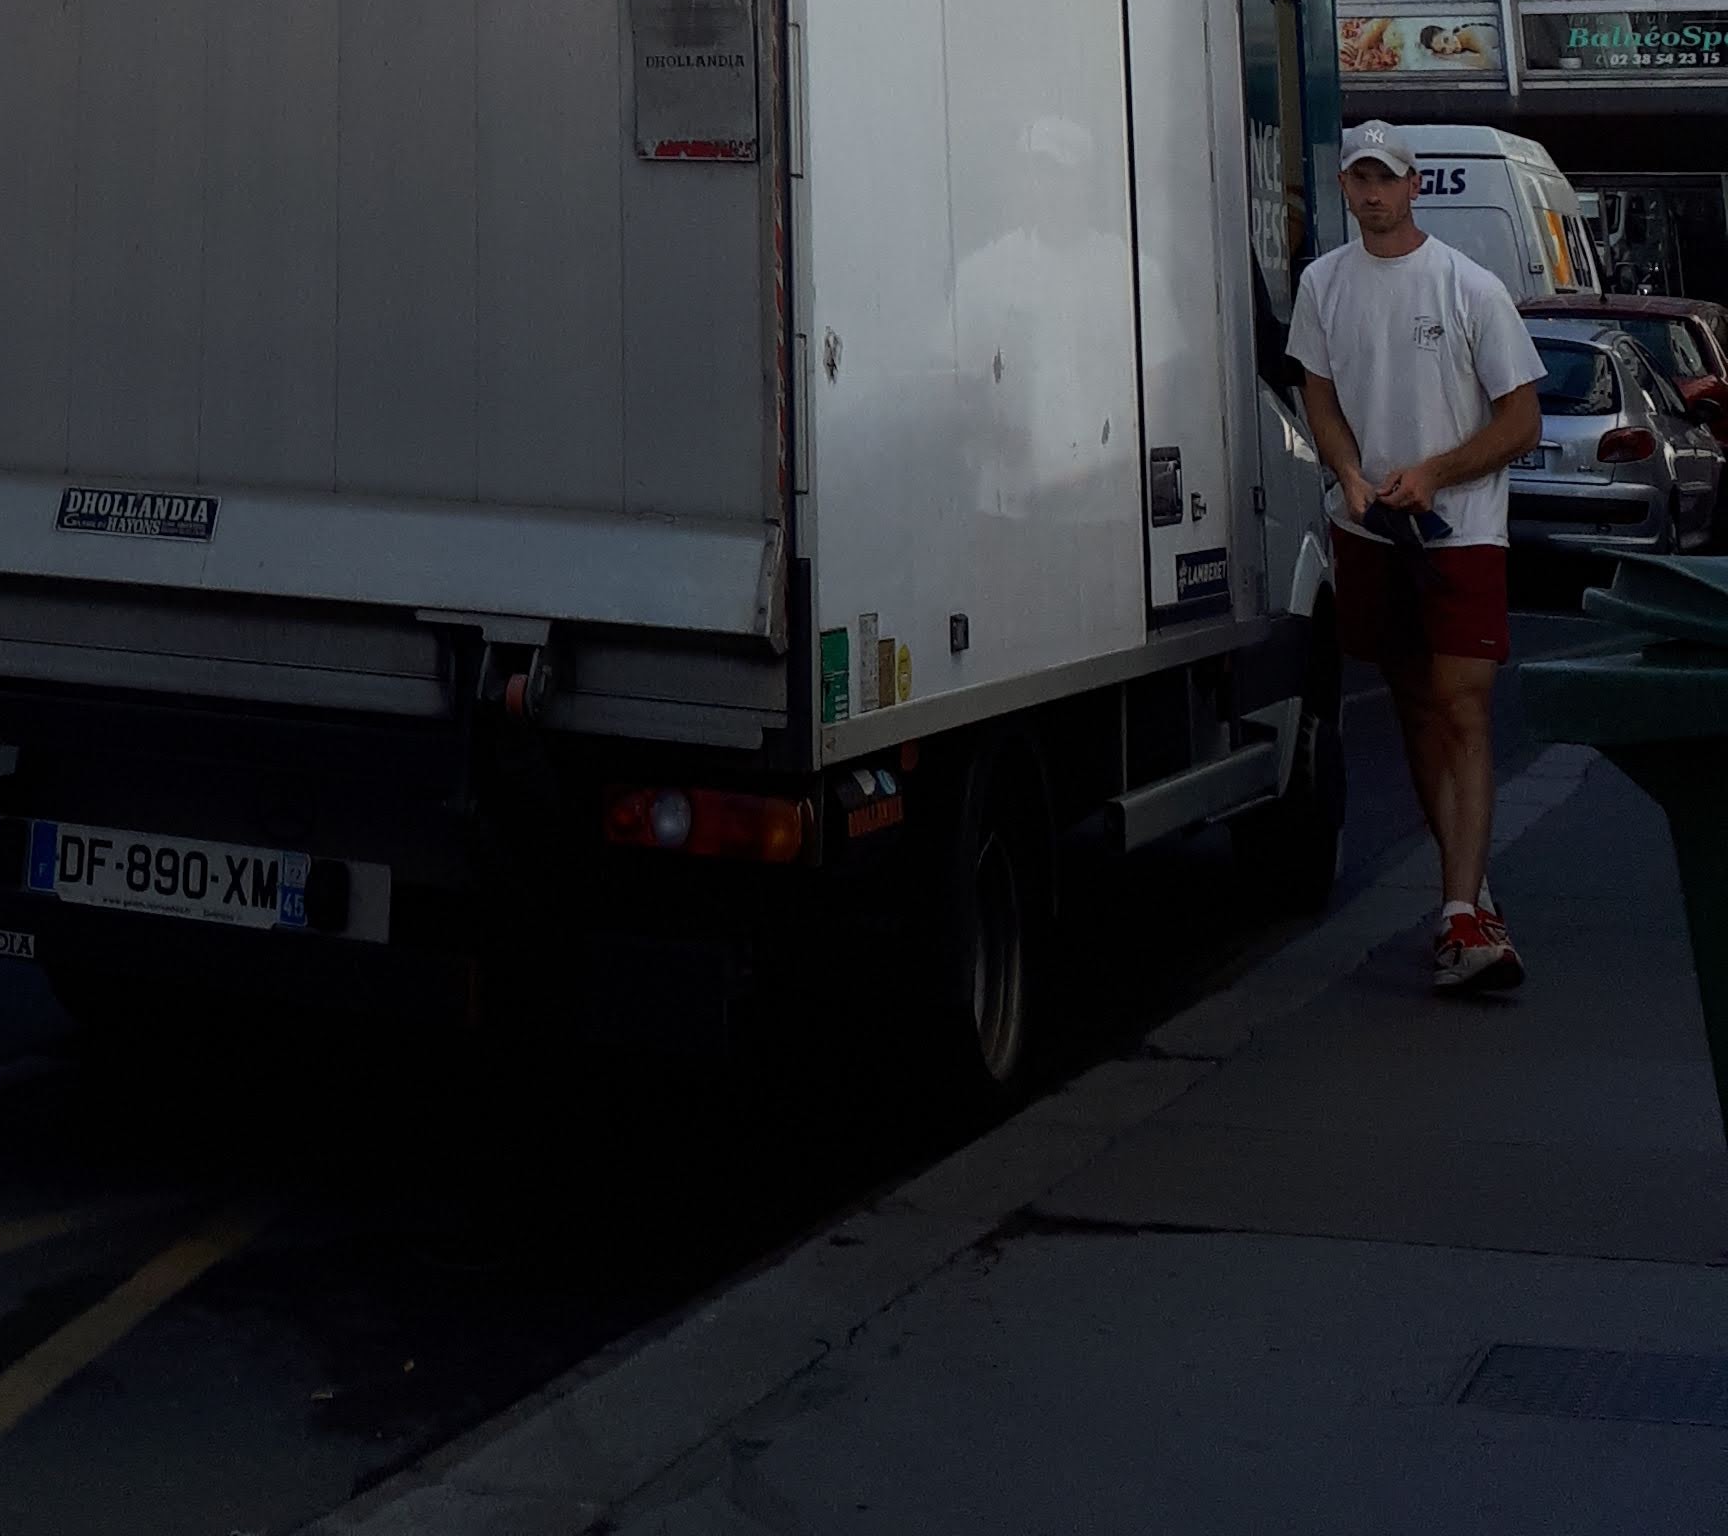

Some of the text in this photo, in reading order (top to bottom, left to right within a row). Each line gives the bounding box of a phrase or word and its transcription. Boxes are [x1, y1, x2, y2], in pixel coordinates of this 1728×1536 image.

[645, 54, 745, 68] DHOLLANDIA
[1610, 52, 1721, 65] 02 38 54 23 15
[1249, 117, 1282, 193] NCE
[1419, 167, 1466, 195] GLS
[1251, 197, 1290, 272] RESS
[65, 489, 209, 523] DHOLLANDIA
[106, 516, 161, 535] HAYONS
[1187, 560, 1226, 585] LAMBERET
[58, 833, 279, 910] DF-890-XM
[282, 895, 305, 918] 45
